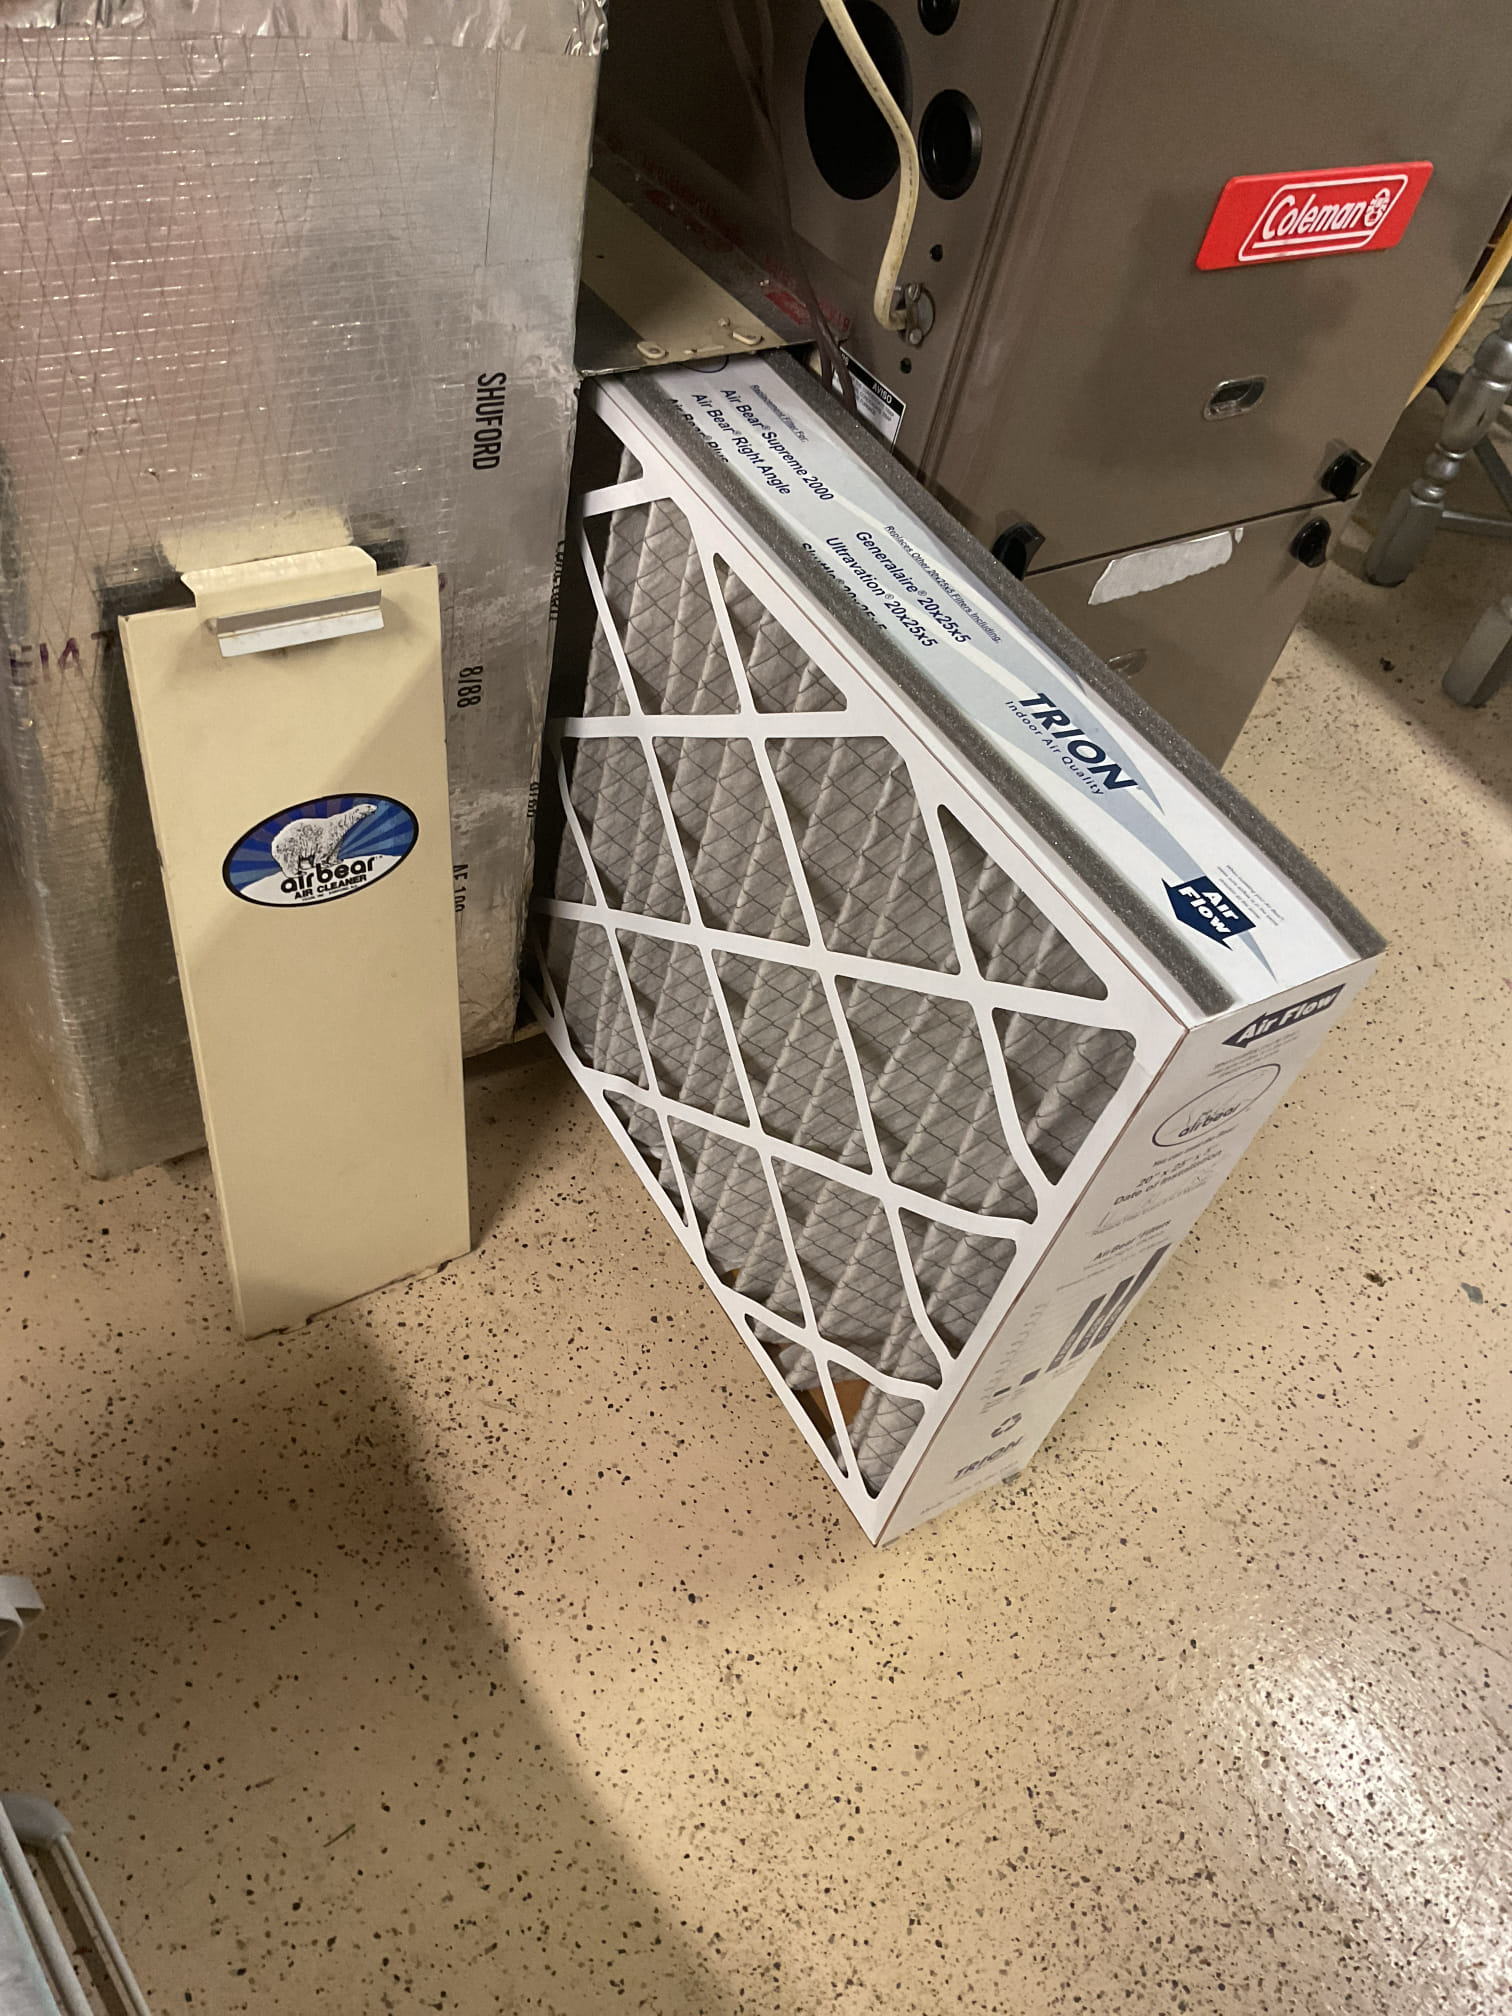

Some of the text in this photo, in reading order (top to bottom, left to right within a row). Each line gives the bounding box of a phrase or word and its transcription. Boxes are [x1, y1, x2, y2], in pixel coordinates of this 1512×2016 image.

[1262, 194, 1367, 240] Coleman
[872, 383, 892, 404] AVISO
[473, 372, 507, 470] SHUFORD
[692, 394, 712, 408] Air
[732, 436, 764, 464] Right
[757, 464, 790, 495] Angle
[720, 389, 741, 404] Air
[762, 431, 808, 476] Supreme
[804, 475, 834, 500] 2000
[885, 525, 913, 553] Replaces
[911, 552, 930, 571] Other
[953, 592, 972, 614] Filters
[884, 601, 938, 647] 20x25x5
[917, 597, 972, 643] 20x25x5
[458, 665, 483, 709] 8/88
[1005, 701, 1104, 795] Indoor Air Quality
[1019, 693, 1138, 790] TRION
[295, 888, 314, 900] AIR
[316, 874, 367, 893] CLEANER
[1178, 886, 1231, 933] Flow
[1279, 993, 1339, 1026] Flow
